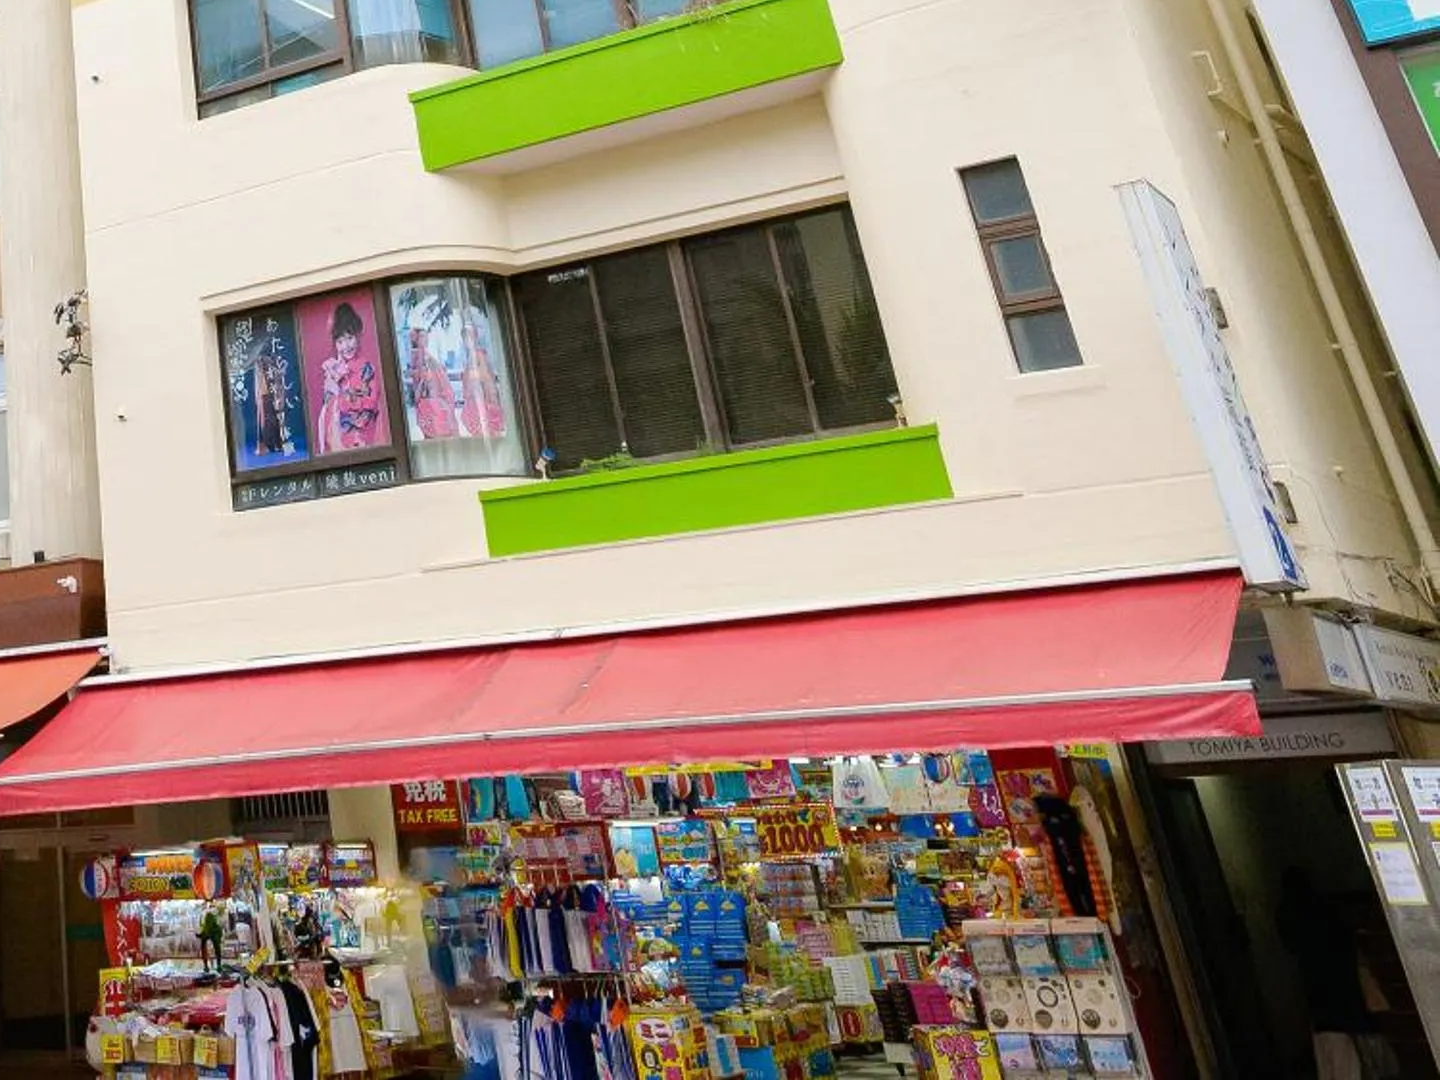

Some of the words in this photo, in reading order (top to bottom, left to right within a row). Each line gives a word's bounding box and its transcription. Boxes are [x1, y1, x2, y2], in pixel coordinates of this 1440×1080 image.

[1188, 737, 1255, 756] TOMIYA
[1259, 732, 1345, 753] BUILDING
[398, 808, 424, 825] TAX
[426, 808, 459, 824] FREE
